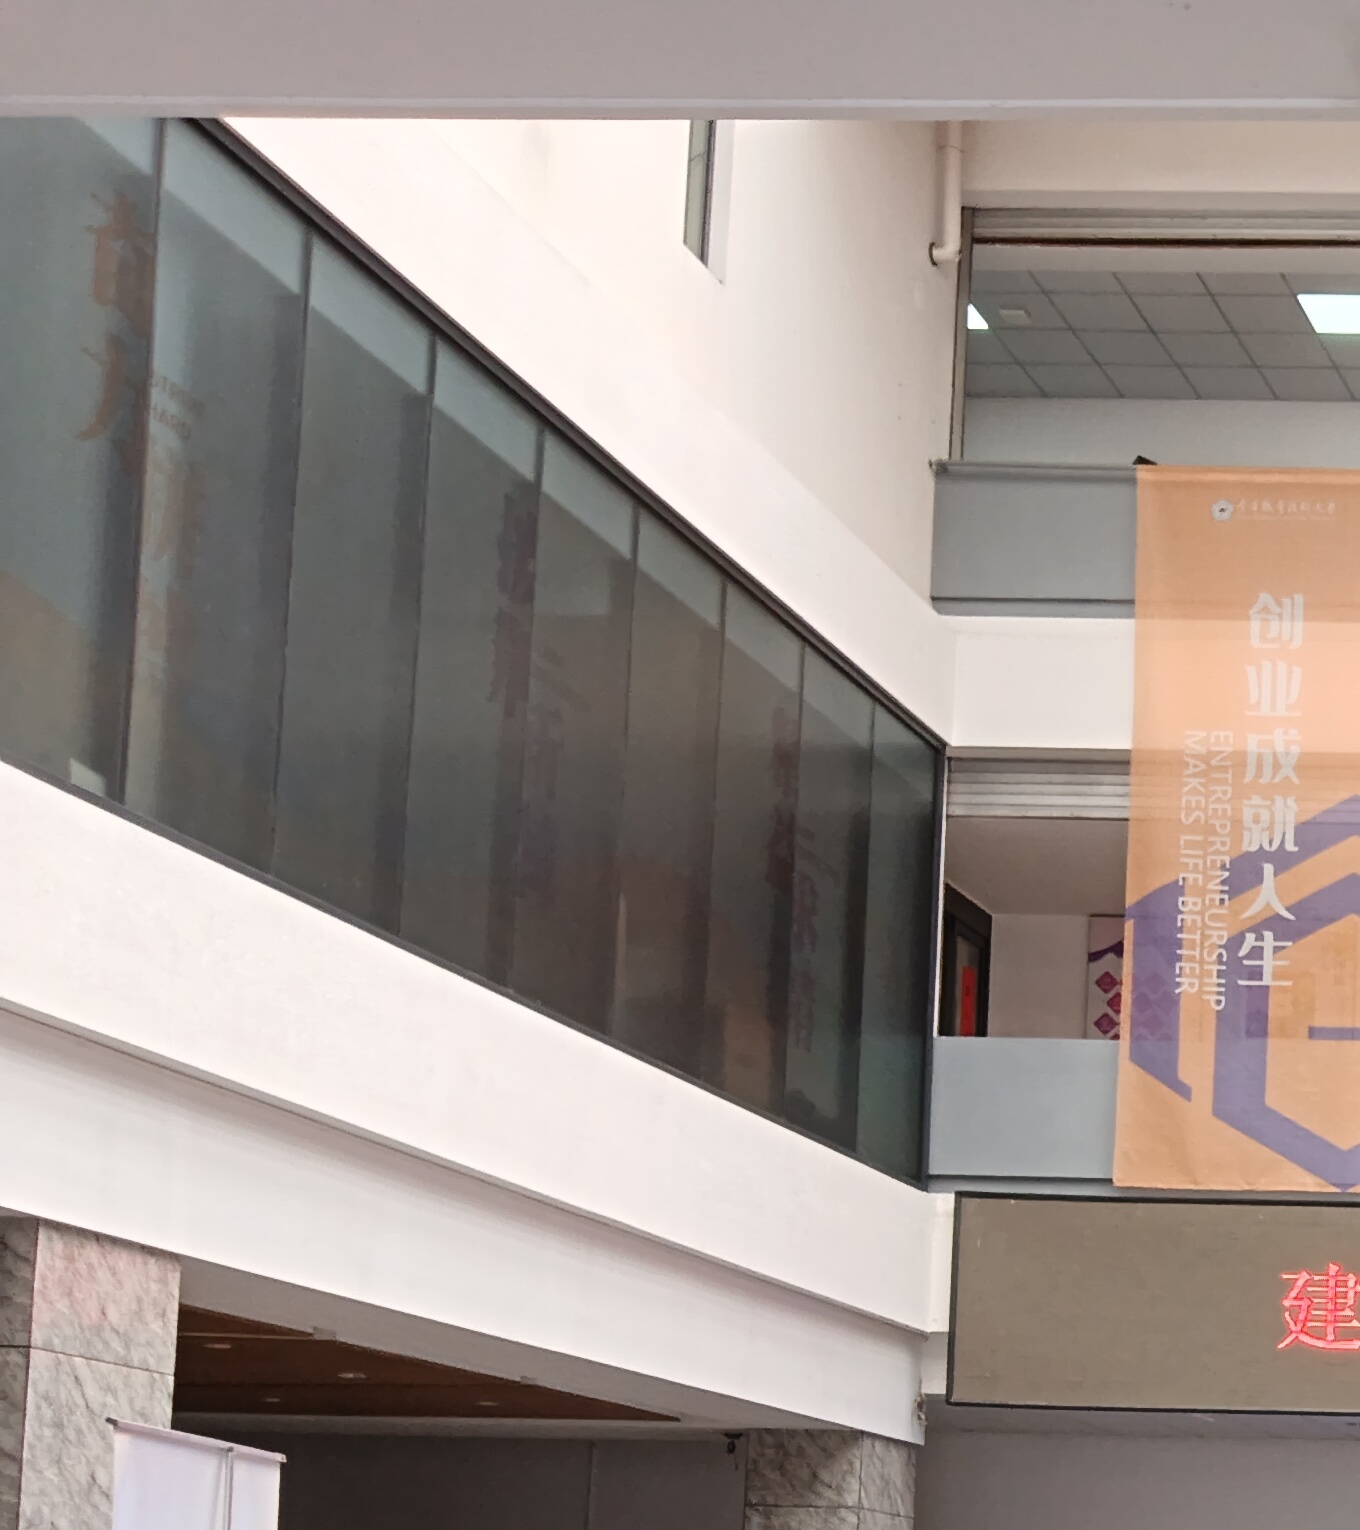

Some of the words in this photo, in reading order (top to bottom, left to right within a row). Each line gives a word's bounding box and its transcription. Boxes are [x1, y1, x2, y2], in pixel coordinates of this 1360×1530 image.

[1180, 730, 1208, 825] MAKES
[1237, 592, 1305, 987] 创业成就人生
[1177, 834, 1206, 887] LIFE
[1201, 730, 1234, 1012] ENTREPRENEURSHIP
[1174, 896, 1202, 995] BETTER
